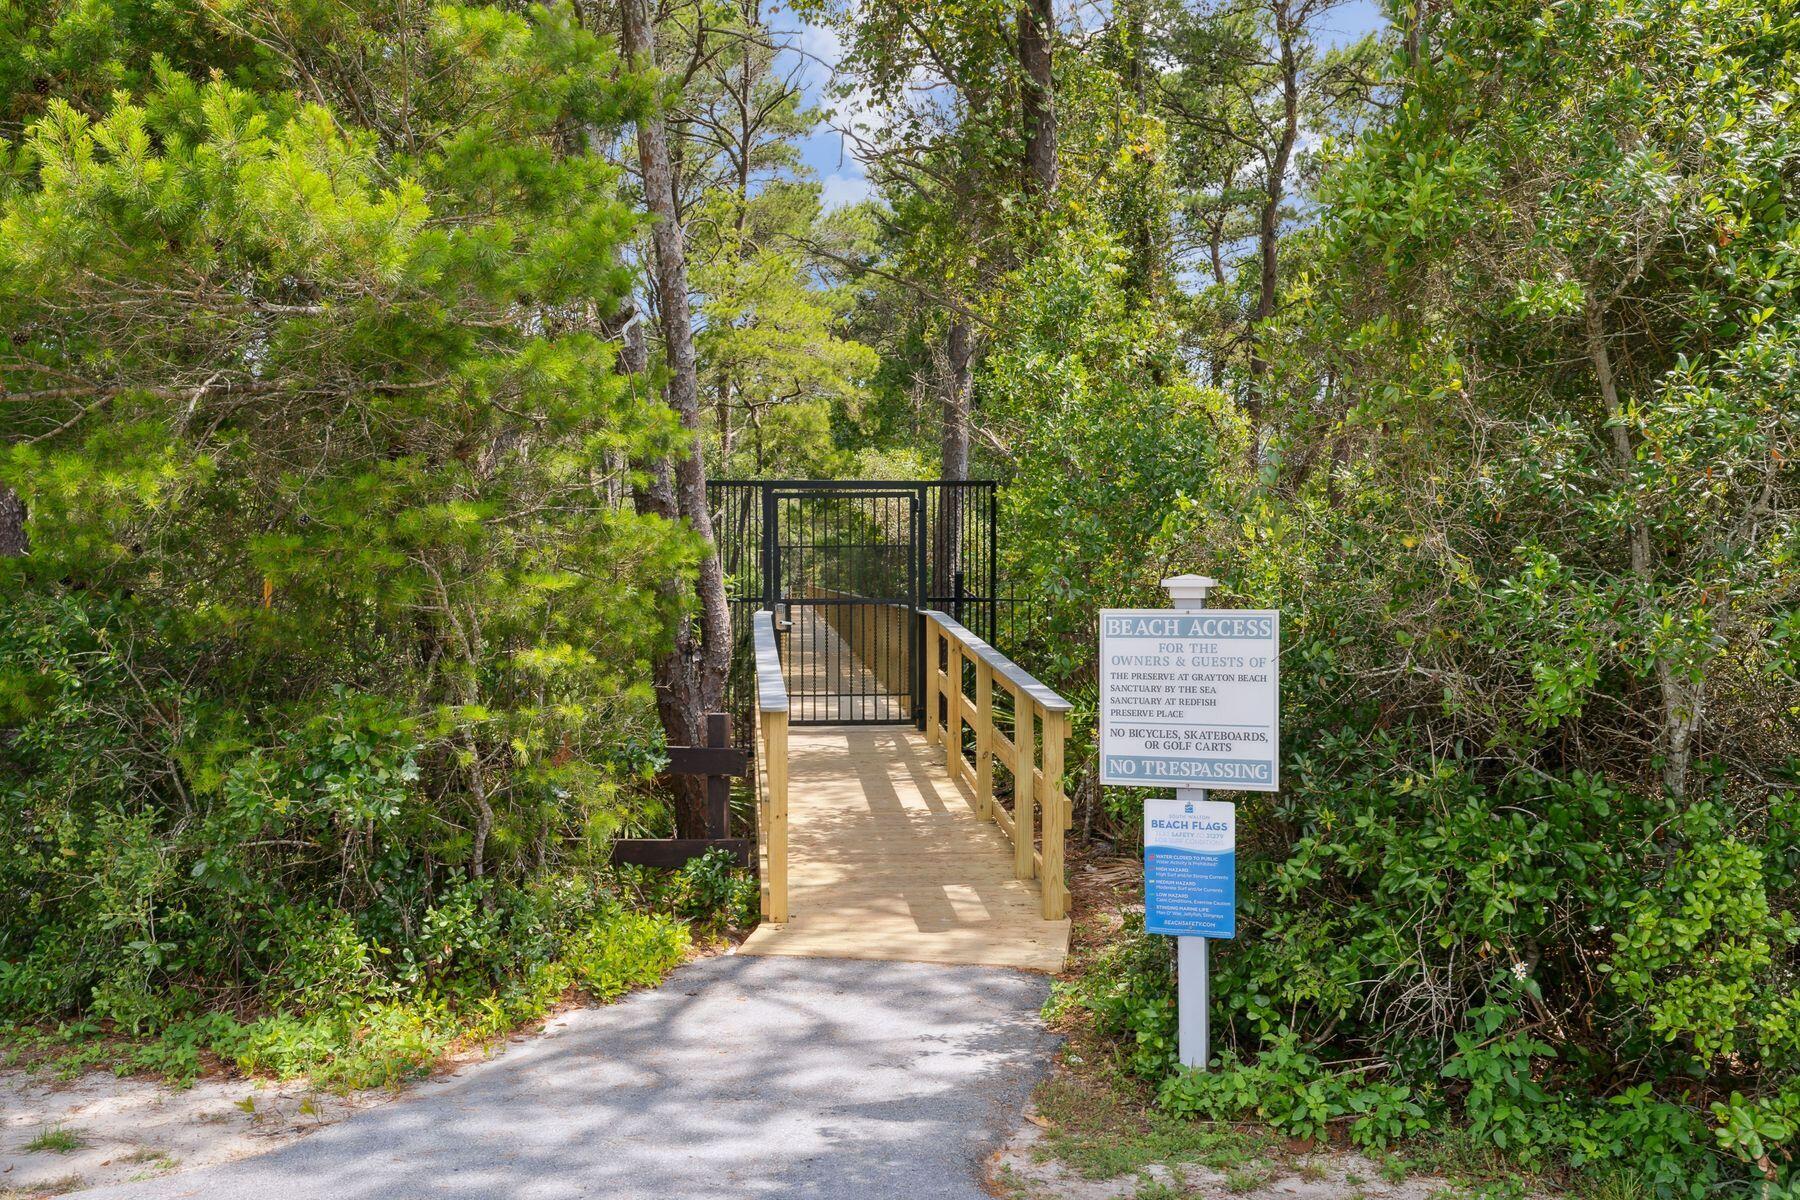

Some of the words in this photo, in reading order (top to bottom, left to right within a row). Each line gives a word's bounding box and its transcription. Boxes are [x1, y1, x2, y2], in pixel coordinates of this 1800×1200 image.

[1107, 619, 1180, 636] BEACH
[1188, 619, 1271, 637] ACCESS
[1159, 642, 1184, 653] FOR
[1189, 643, 1218, 654] THE
[1111, 655, 1170, 667] OWNERS
[1175, 656, 1186, 667] &
[1191, 656, 1244, 668] GUESTS
[1249, 657, 1267, 668] OF
[1110, 672, 1129, 680] THE
[1131, 672, 1175, 681] PRESERVE
[1177, 673, 1190, 681] AT
[1191, 673, 1235, 682] GRAYTON
[1237, 674, 1267, 683] BEACH
[1110, 684, 1162, 693] SANCTUARY
[1164, 685, 1176, 693] BY
[1178, 686, 1197, 694] THE
[1199, 686, 1217, 694] SEA
[1110, 696, 1162, 705] SANCTUARY
[1164, 697, 1177, 706] AT
[1179, 698, 1217, 707] REDFISH
[1110, 709, 1154, 717] PRESERVE
[1156, 710, 1184, 718] PLACE
[1110, 728, 1125, 738] NO
[1129, 728, 1181, 740] BICYCLES,
[1184, 730, 1268, 743] SKATEBOARDS,
[1144, 740, 1160, 750] OR
[1163, 741, 1192, 751] GOLF
[1195, 742, 1232, 752] CARTS
[1110, 759, 1136, 775] NO
[1141, 760, 1269, 780] TRESPASSING
[1151, 820, 1188, 830] BEACH
[1192, 821, 1228, 831] FLAGS
[1164, 920, 1216, 928] BEACHSAFETY.COM
